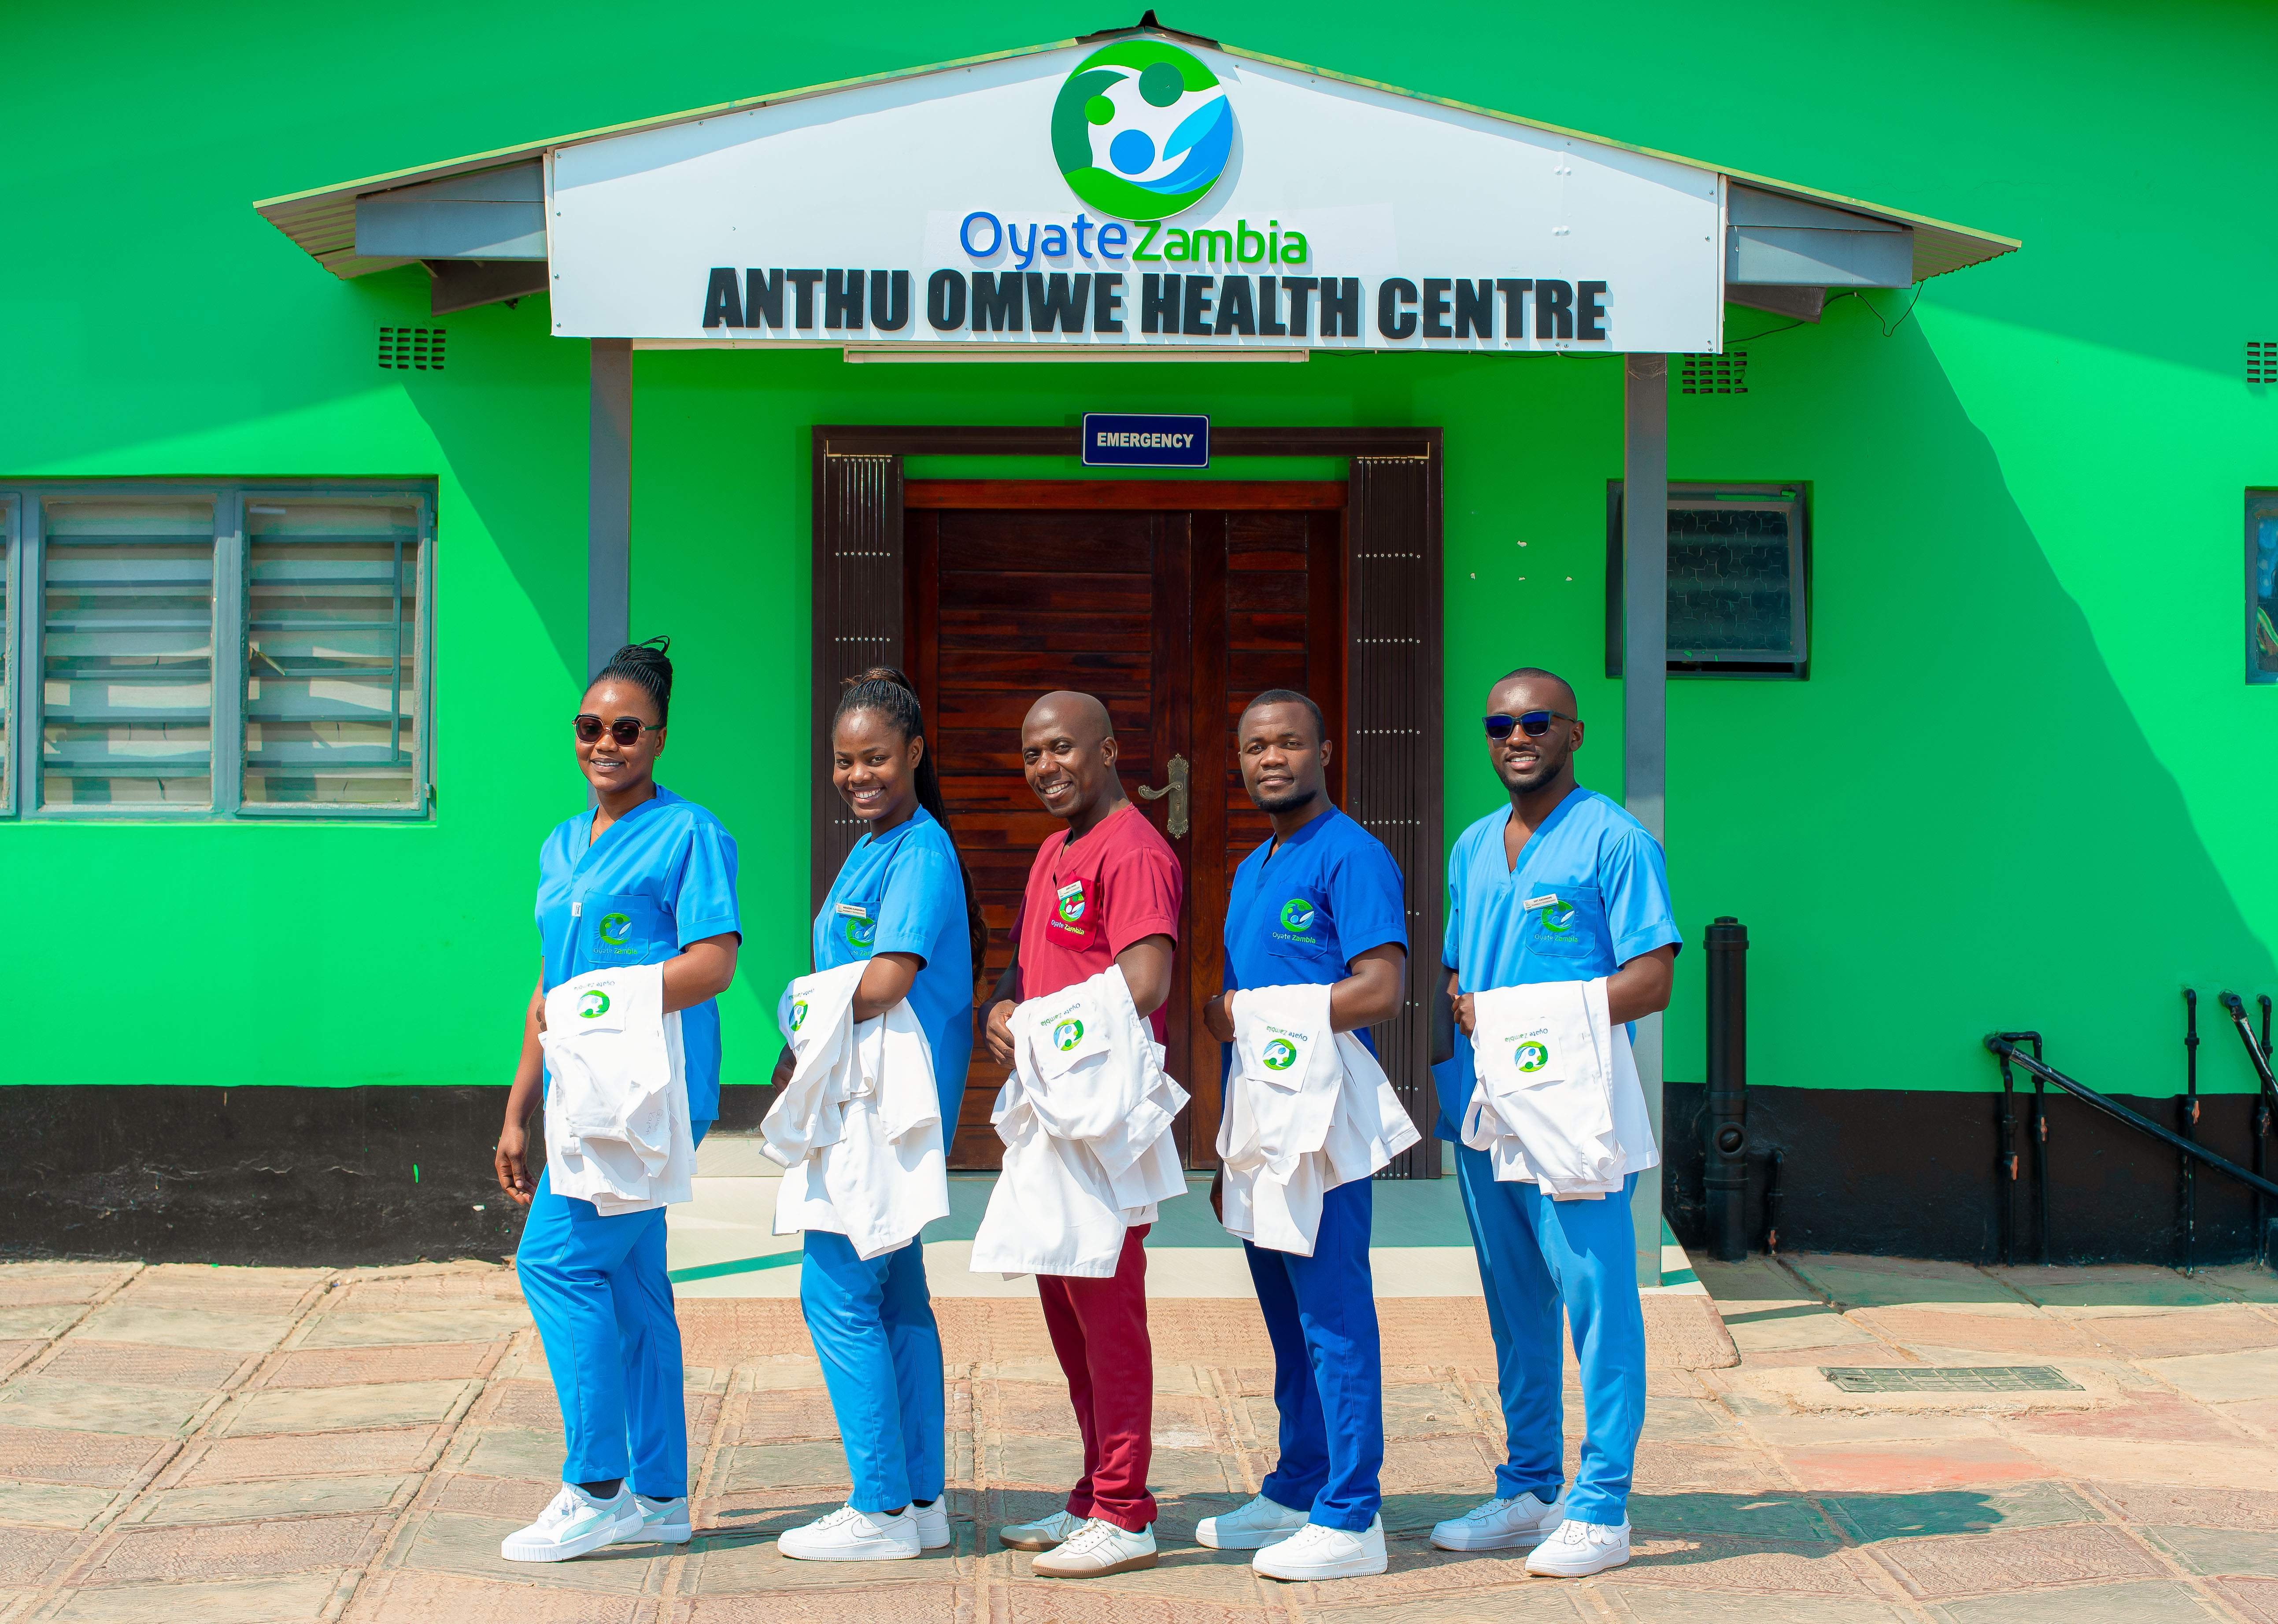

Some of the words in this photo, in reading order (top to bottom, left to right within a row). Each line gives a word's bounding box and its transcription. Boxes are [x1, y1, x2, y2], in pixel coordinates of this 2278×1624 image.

[703, 268, 910, 331] ANTHU
[927, 269, 1123, 334] OMWE
[1141, 273, 1359, 337] HEALTH
[1377, 278, 1607, 340] CENTRE
[1097, 432, 1194, 448] EMERGENCY
[1051, 919, 1064, 928] Oyate
[1064, 923, 1084, 935] Zambia
[1292, 934, 1316, 944] Zambia
[1266, 1026, 1287, 1036] Zambia
[1288, 1031, 1308, 1041] Oyate
[1529, 1028, 1548, 1037] Oyate
[1505, 1033, 1528, 1042] Zambia
